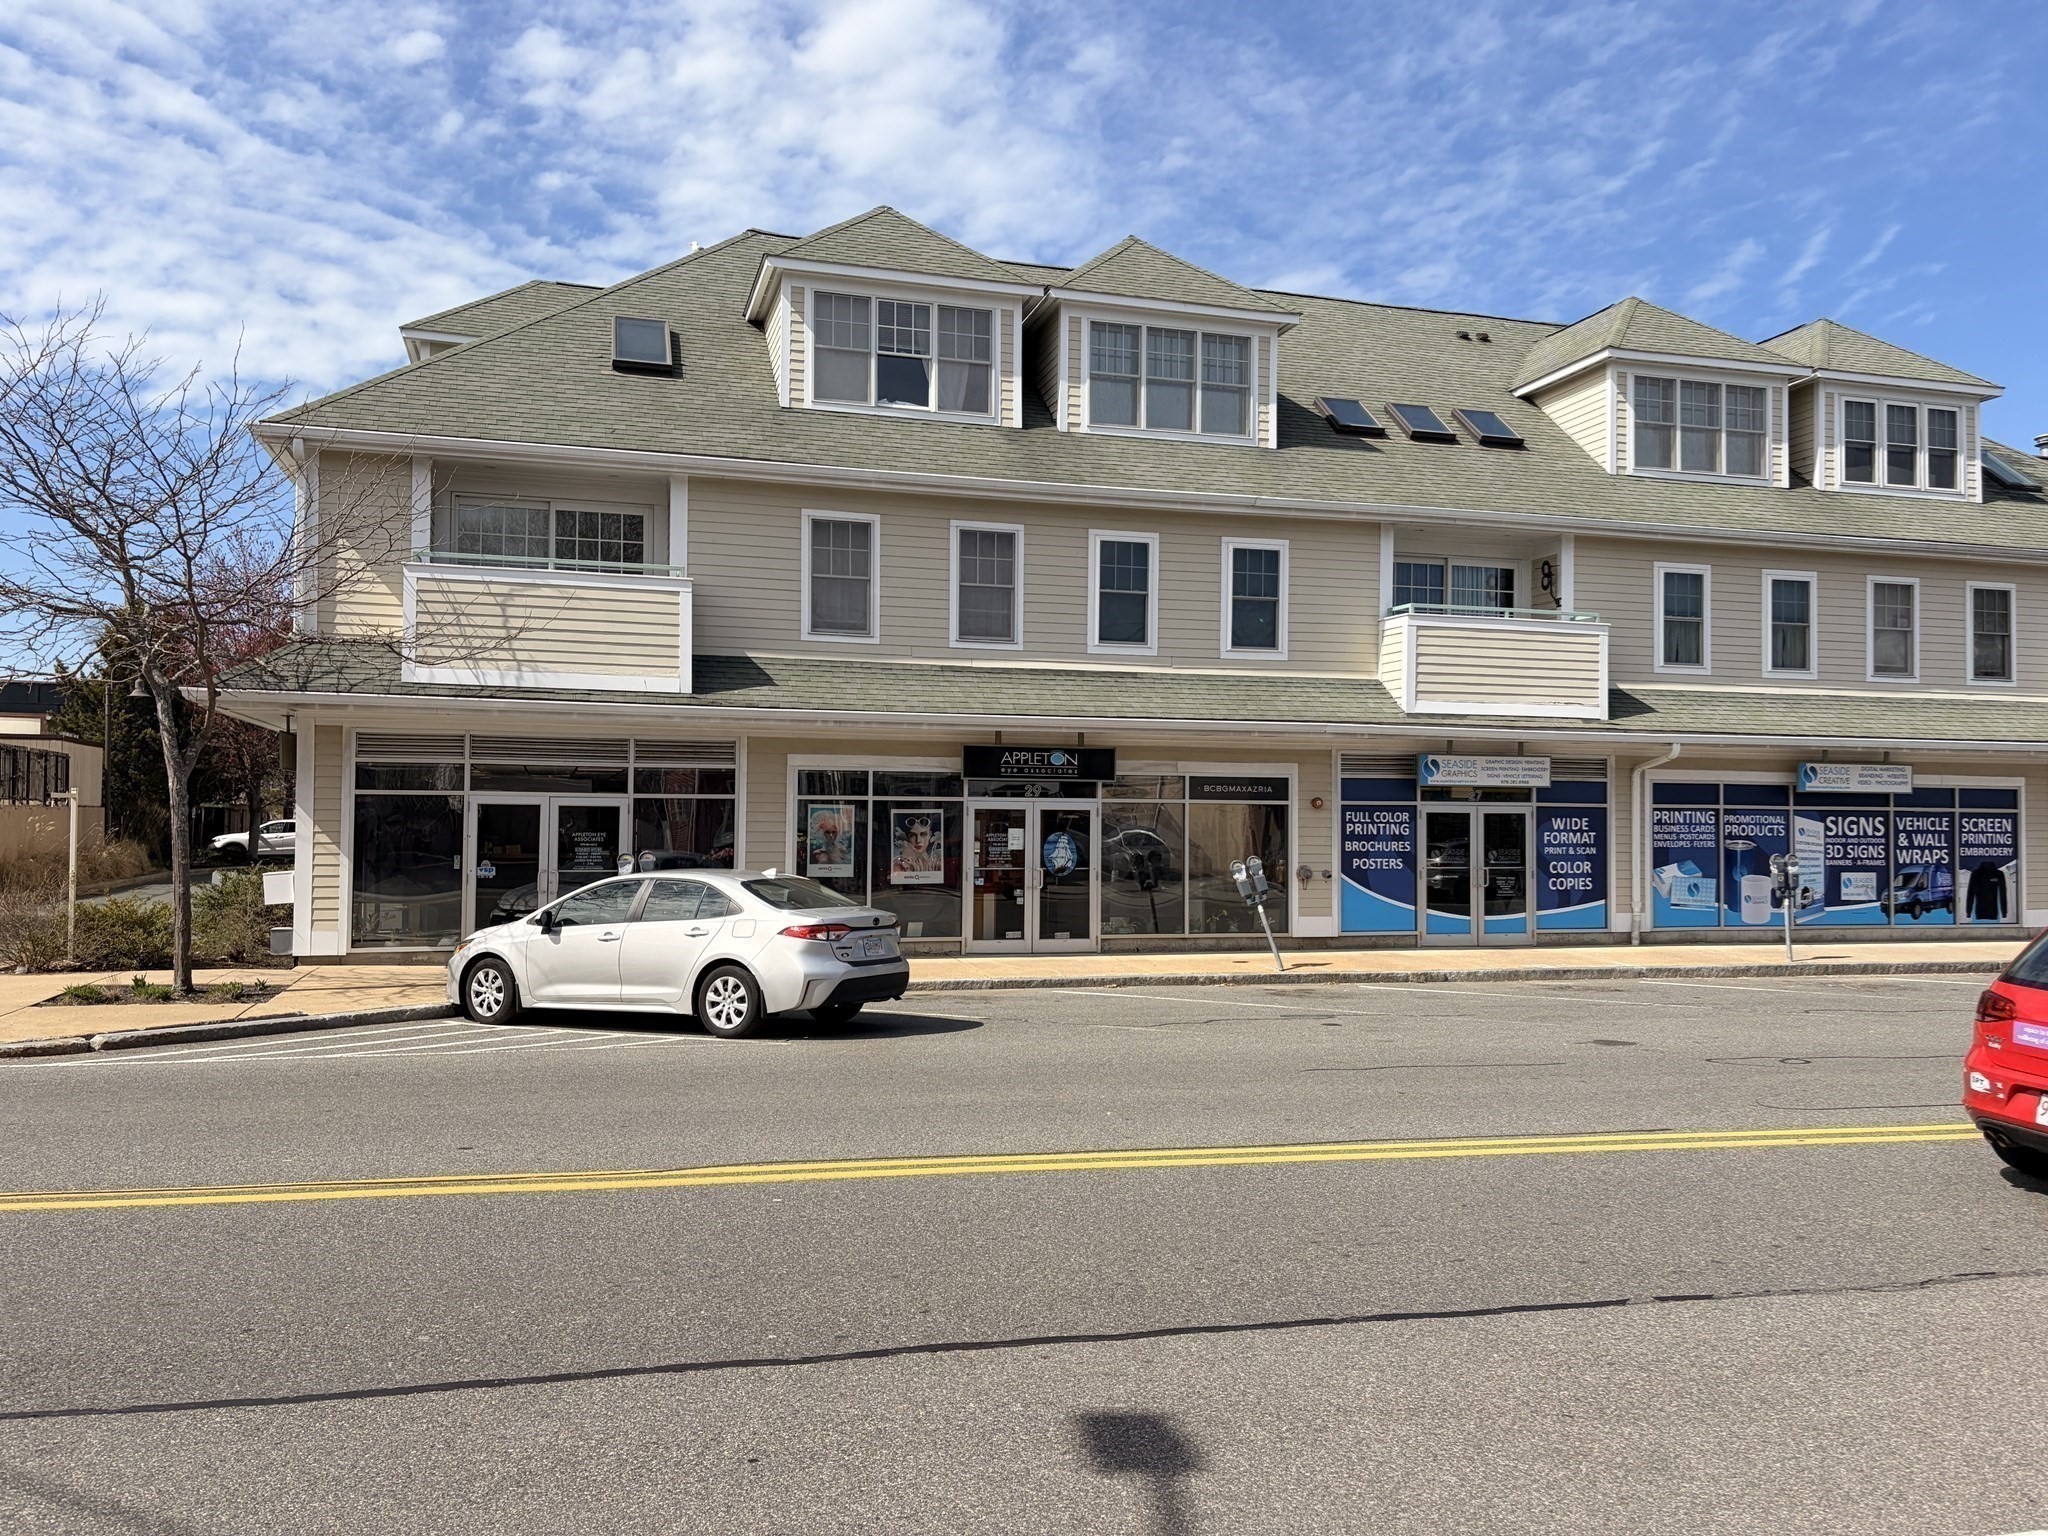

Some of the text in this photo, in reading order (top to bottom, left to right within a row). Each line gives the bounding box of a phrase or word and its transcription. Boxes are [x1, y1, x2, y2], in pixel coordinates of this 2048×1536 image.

[1000, 751, 1078, 766] APPLETON
[1441, 759, 1478, 770] SEASIDE
[1441, 770, 1478, 778] GRAPHICS
[1818, 766, 1850, 776] SEASIDE
[1818, 777, 1850, 785] CREATIVE
[1024, 784, 1042, 797] 29
[1203, 784, 1273, 793] BCBGMAXAZRIA
[1468, 789, 1483, 801] 27
[1345, 811, 1410, 823] FULL COLOR
[1653, 810, 1716, 824] PRINTING
[1724, 815, 1786, 824] PROMOTIONAL
[1346, 823, 1410, 835] PRINTING
[1551, 817, 1589, 830] WIDE
[1653, 825, 1715, 833] BUSINESS CARDS
[1825, 815, 1885, 837] SIGNS
[1896, 817, 1950, 831] VEHICLE
[1961, 817, 2012, 832] SCREEN
[1724, 825, 1785, 836] PRODUCTS
[1543, 832, 1597, 844] FORMAT
[1897, 833, 1948, 847] & WALL
[1961, 833, 2012, 845] PRINTING
[1345, 841, 1411, 852] BROCHURES
[1544, 847, 1597, 855] PRINT & SCAN
[1825, 844, 1886, 858] 3D SIGNS
[1960, 847, 2013, 856] EMBROIDERY
[1896, 849, 1949, 864] WRAPS
[1352, 858, 1403, 869] POSTERS
[1549, 861, 1592, 874] COLOR
[1548, 878, 1593, 890] COPIES
